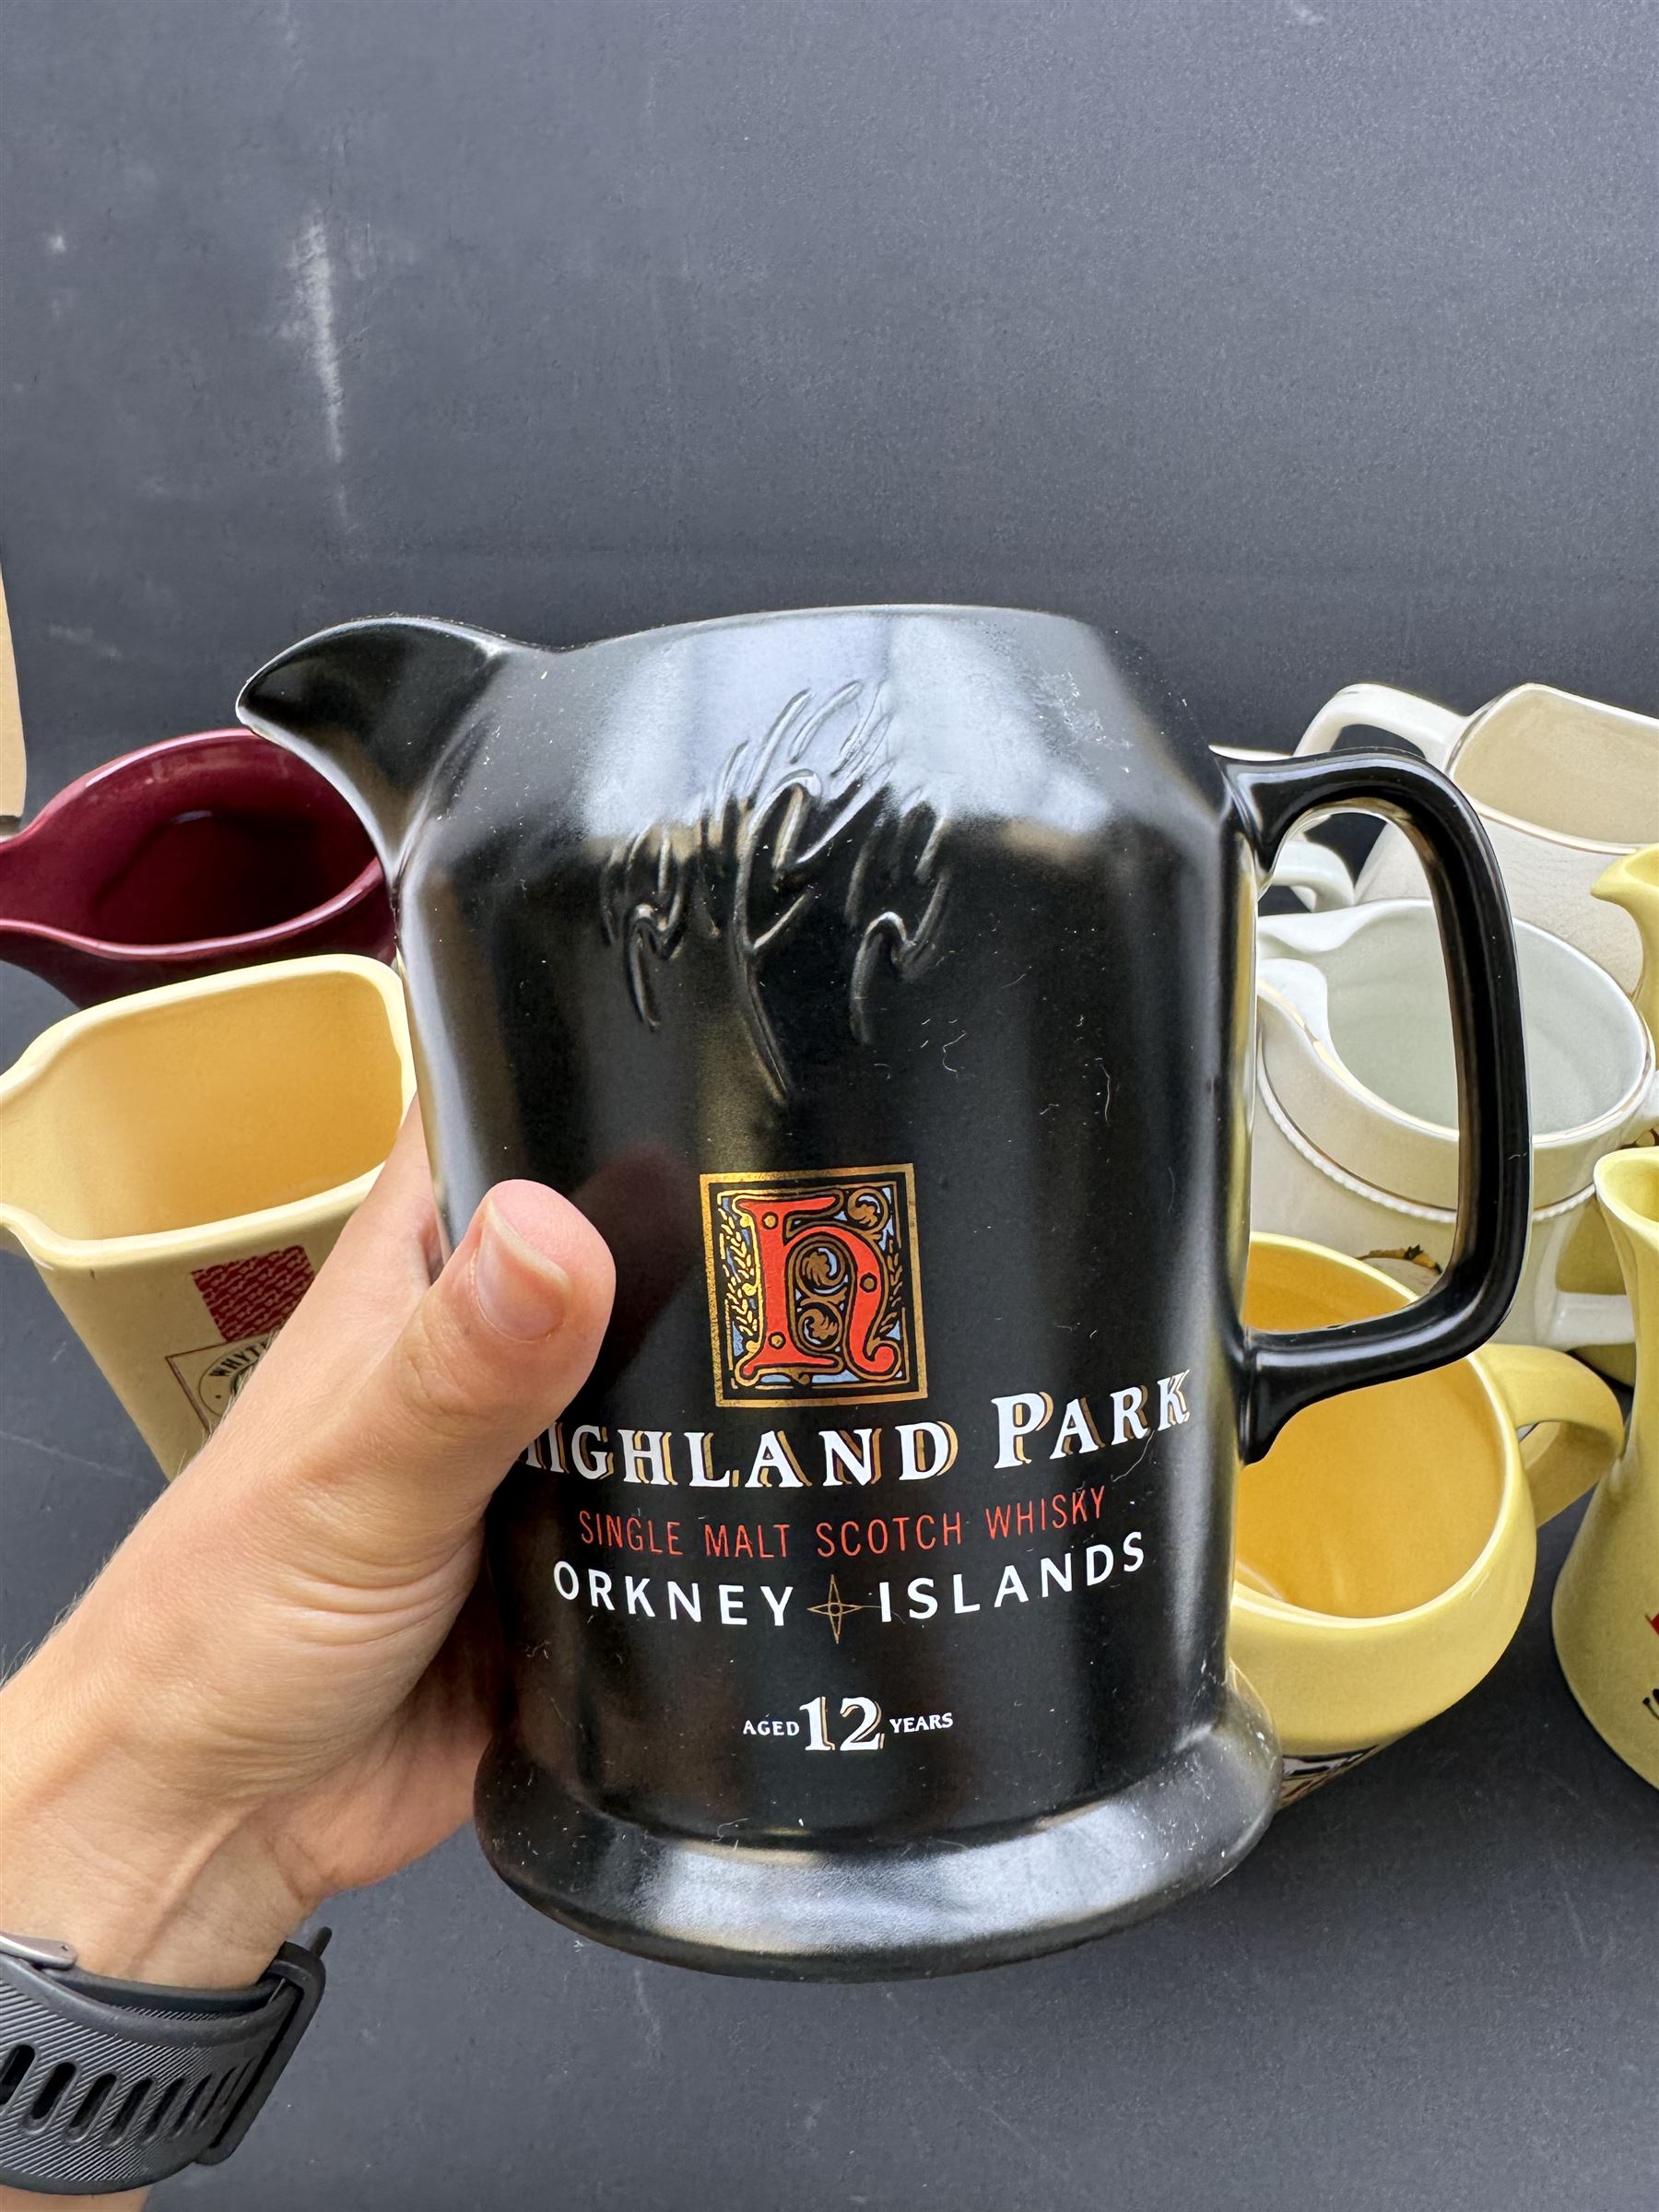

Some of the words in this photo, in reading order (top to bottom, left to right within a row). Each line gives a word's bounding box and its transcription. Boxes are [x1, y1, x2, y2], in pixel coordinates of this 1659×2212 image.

[991, 1369, 1192, 1468] PARK
[578, 1509, 683, 1558] SINGLE
[705, 1523, 792, 1559] MALT
[817, 1512, 963, 1557] SCOTCH
[985, 1485, 1106, 1538] WHISKY
[554, 1560, 794, 1626] ORKNEY
[878, 1531, 1146, 1622] ISLANDS
[743, 1719, 800, 1737] AGED
[799, 1696, 885, 1751] 12
[888, 1712, 954, 1735] YEARS
